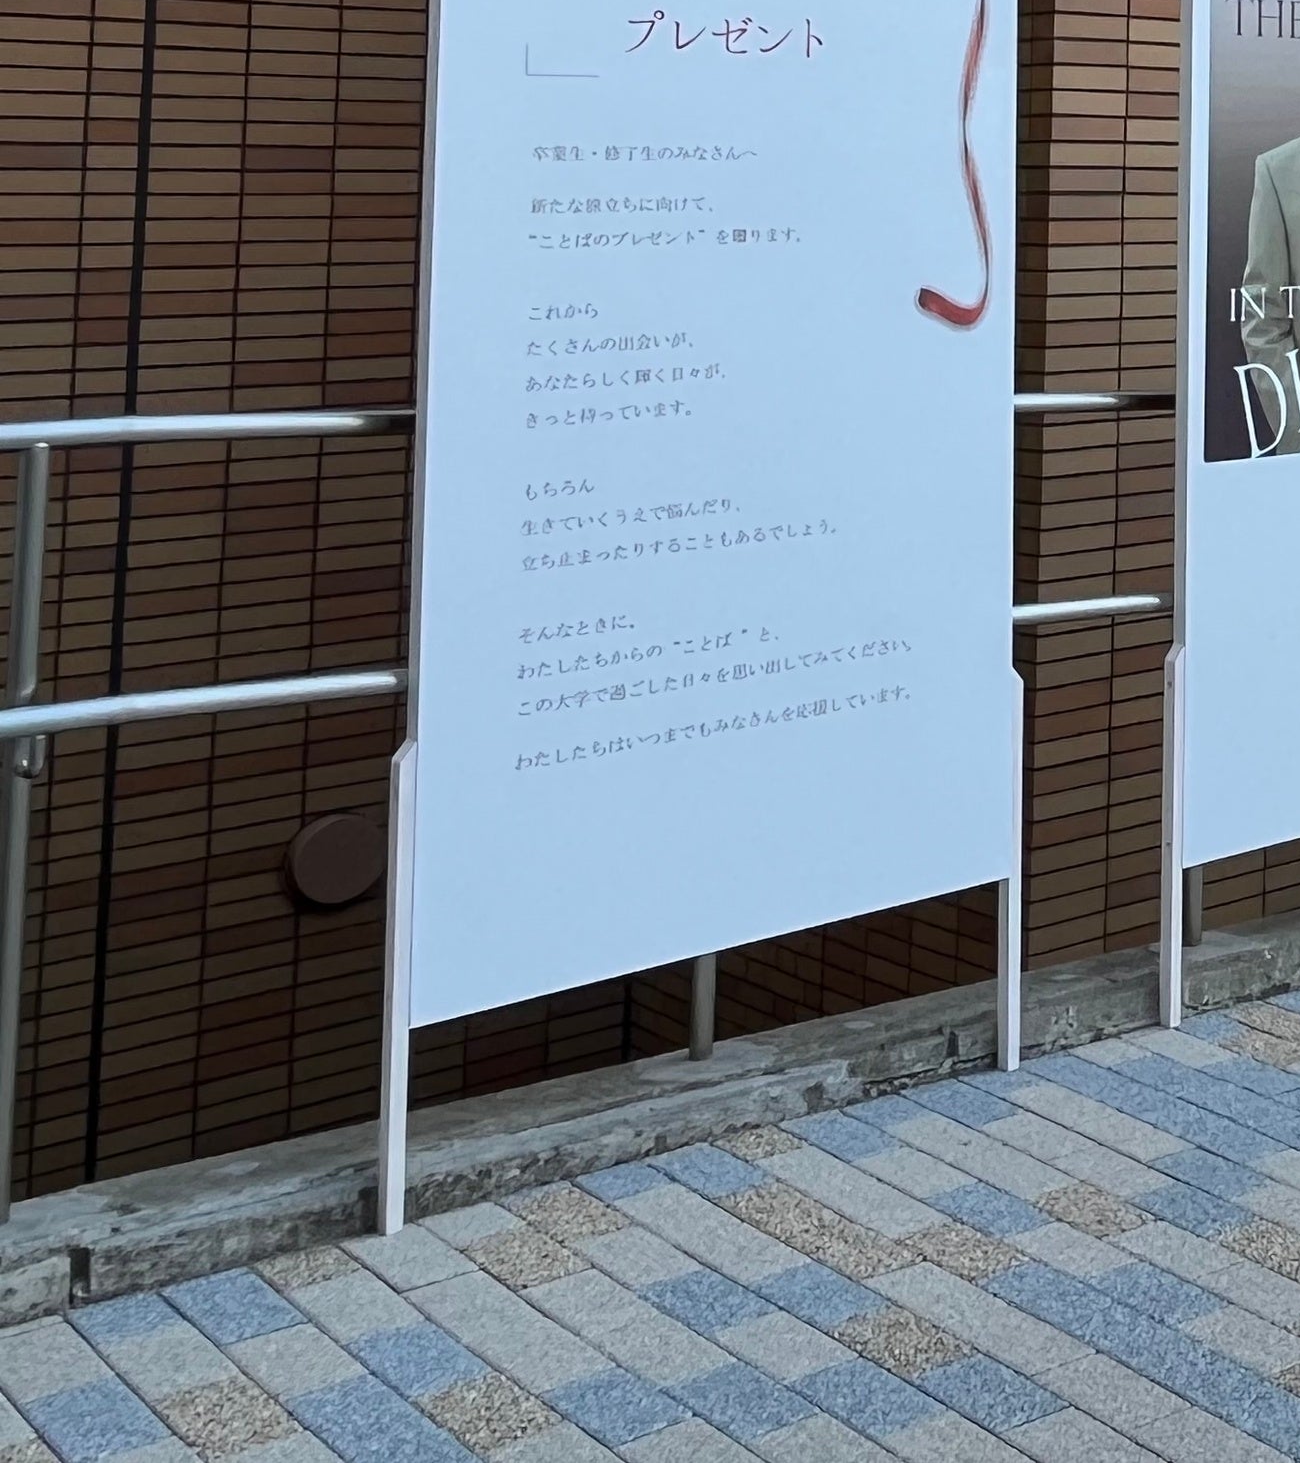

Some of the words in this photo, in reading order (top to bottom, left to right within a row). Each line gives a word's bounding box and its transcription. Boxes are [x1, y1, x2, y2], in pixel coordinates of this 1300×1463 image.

[624, 8, 825, 60] プレゼント
[528, 302, 599, 321] これから
[1229, 286, 1267, 322] IN
[526, 399, 692, 429] きっと待っています。
